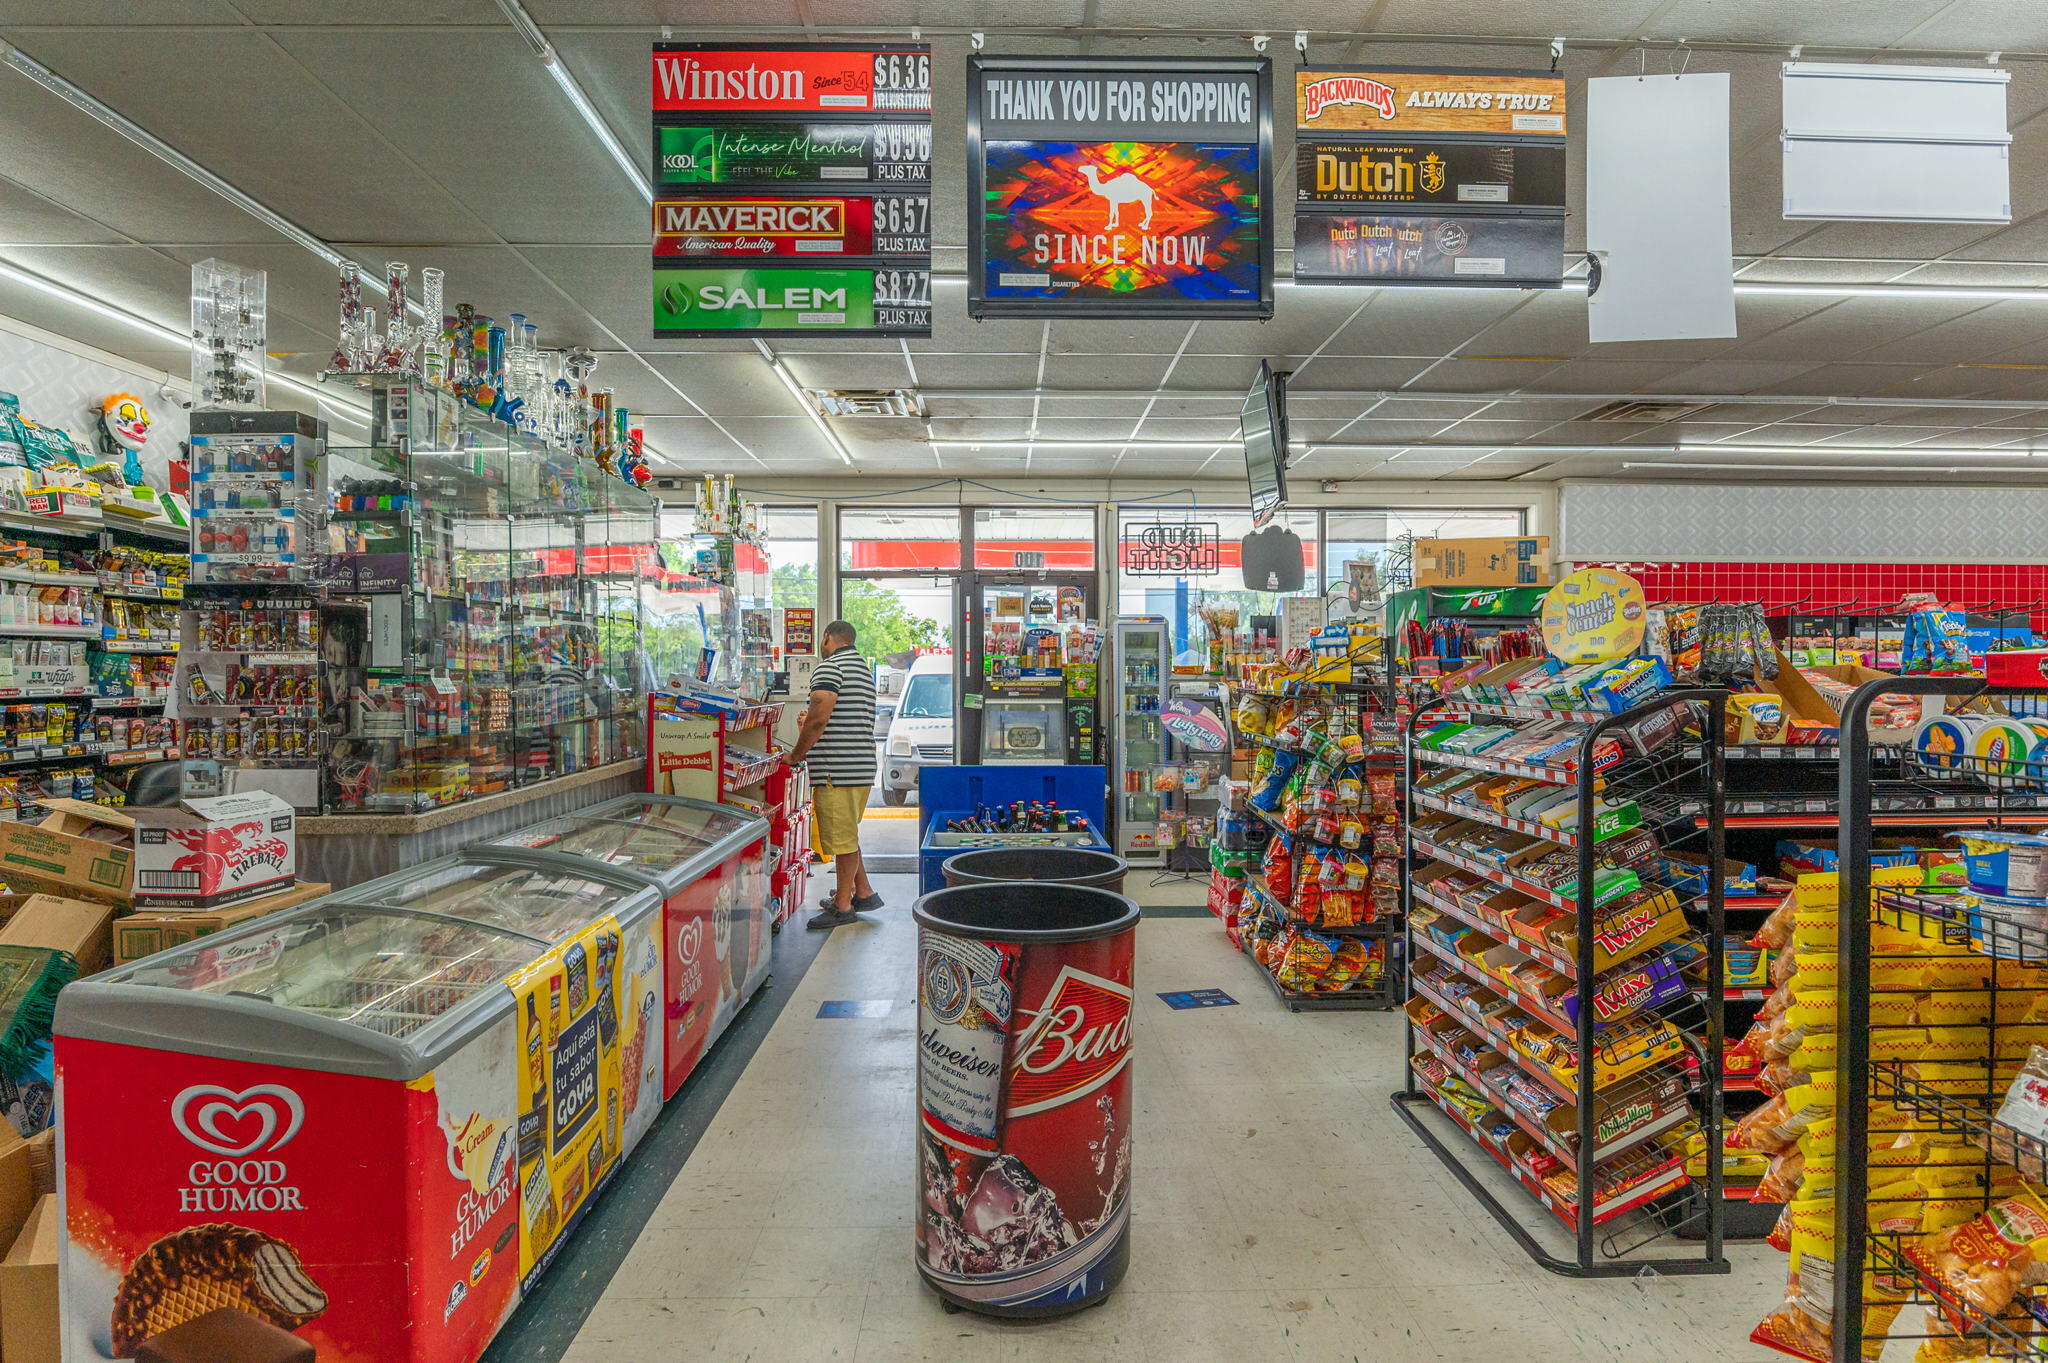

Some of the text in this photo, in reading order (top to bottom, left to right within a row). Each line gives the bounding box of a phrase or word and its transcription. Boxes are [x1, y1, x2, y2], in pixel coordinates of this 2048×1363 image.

[655, 58, 805, 100] Winston
[812, 76, 842, 89] Since
[874, 54, 929, 89] $6.36
[987, 79, 1251, 123] THANK YOU FOR SHOPPING
[1306, 79, 1396, 118] BACKWOODS
[1406, 91, 1554, 111] ALWAYS TRUE
[718, 133, 865, 160] Intense Menthol
[663, 154, 698, 168] KOOL
[775, 163, 799, 178] Vibe
[878, 165, 904, 178] PLUS
[906, 165, 926, 178] TAX
[1316, 155, 1414, 193] Dutch
[666, 207, 834, 231] MAVERICK
[874, 198, 929, 234] $6.57
[677, 236, 776, 253] American Quality
[878, 238, 925, 250] PLUS TAX
[1361, 225, 1393, 239] Dutch
[1397, 229, 1423, 243] utch
[1034, 234, 1206, 265] SINCE NOW
[1375, 242, 1422, 259] Leaf Leaf
[699, 286, 846, 309] SALEM
[874, 271, 929, 306] $8.27
[879, 311, 927, 324] PLUS TAX
[29, 497, 47, 505] RED
[1460, 590, 1497, 611] 7UP
[1566, 592, 1615, 618] Snack
[1567, 607, 1615, 636] Center
[1619, 667, 1655, 697] mentos
[1169, 699, 1192, 717] Wonka
[1748, 704, 1778, 713] Famous
[1171, 716, 1223, 748] Laffy Taffy
[1641, 707, 1675, 736] HERSHEY'S
[660, 733, 685, 741] Unwrap
[662, 757, 710, 766] Little Debbie
[1600, 820, 1620, 835] ICE
[231, 853, 283, 882] FIREBALL
[1946, 928, 1968, 936] GOYA
[567, 947, 585, 968] GOYA
[681, 960, 700, 986] GOOD
[598, 986, 612, 1011] GOYA
[679, 974, 703, 1007] HUMOR
[1628, 990, 1652, 1009] Dark
[556, 1019, 595, 1070] Aquí está
[556, 1047, 596, 1095] tu sabor
[921, 1048, 968, 1080] ING OF BEERS.
[557, 1073, 593, 1126] GOYA
[521, 1115, 539, 1135] GOYA
[1599, 1104, 1653, 1141] Milky Way
[466, 1123, 494, 1154] Cream
[188, 1161, 287, 1187] GOOD
[526, 1158, 544, 1196] GOYA
[179, 1187, 302, 1213] HUMOR
[450, 1179, 515, 1260] HUMOR
